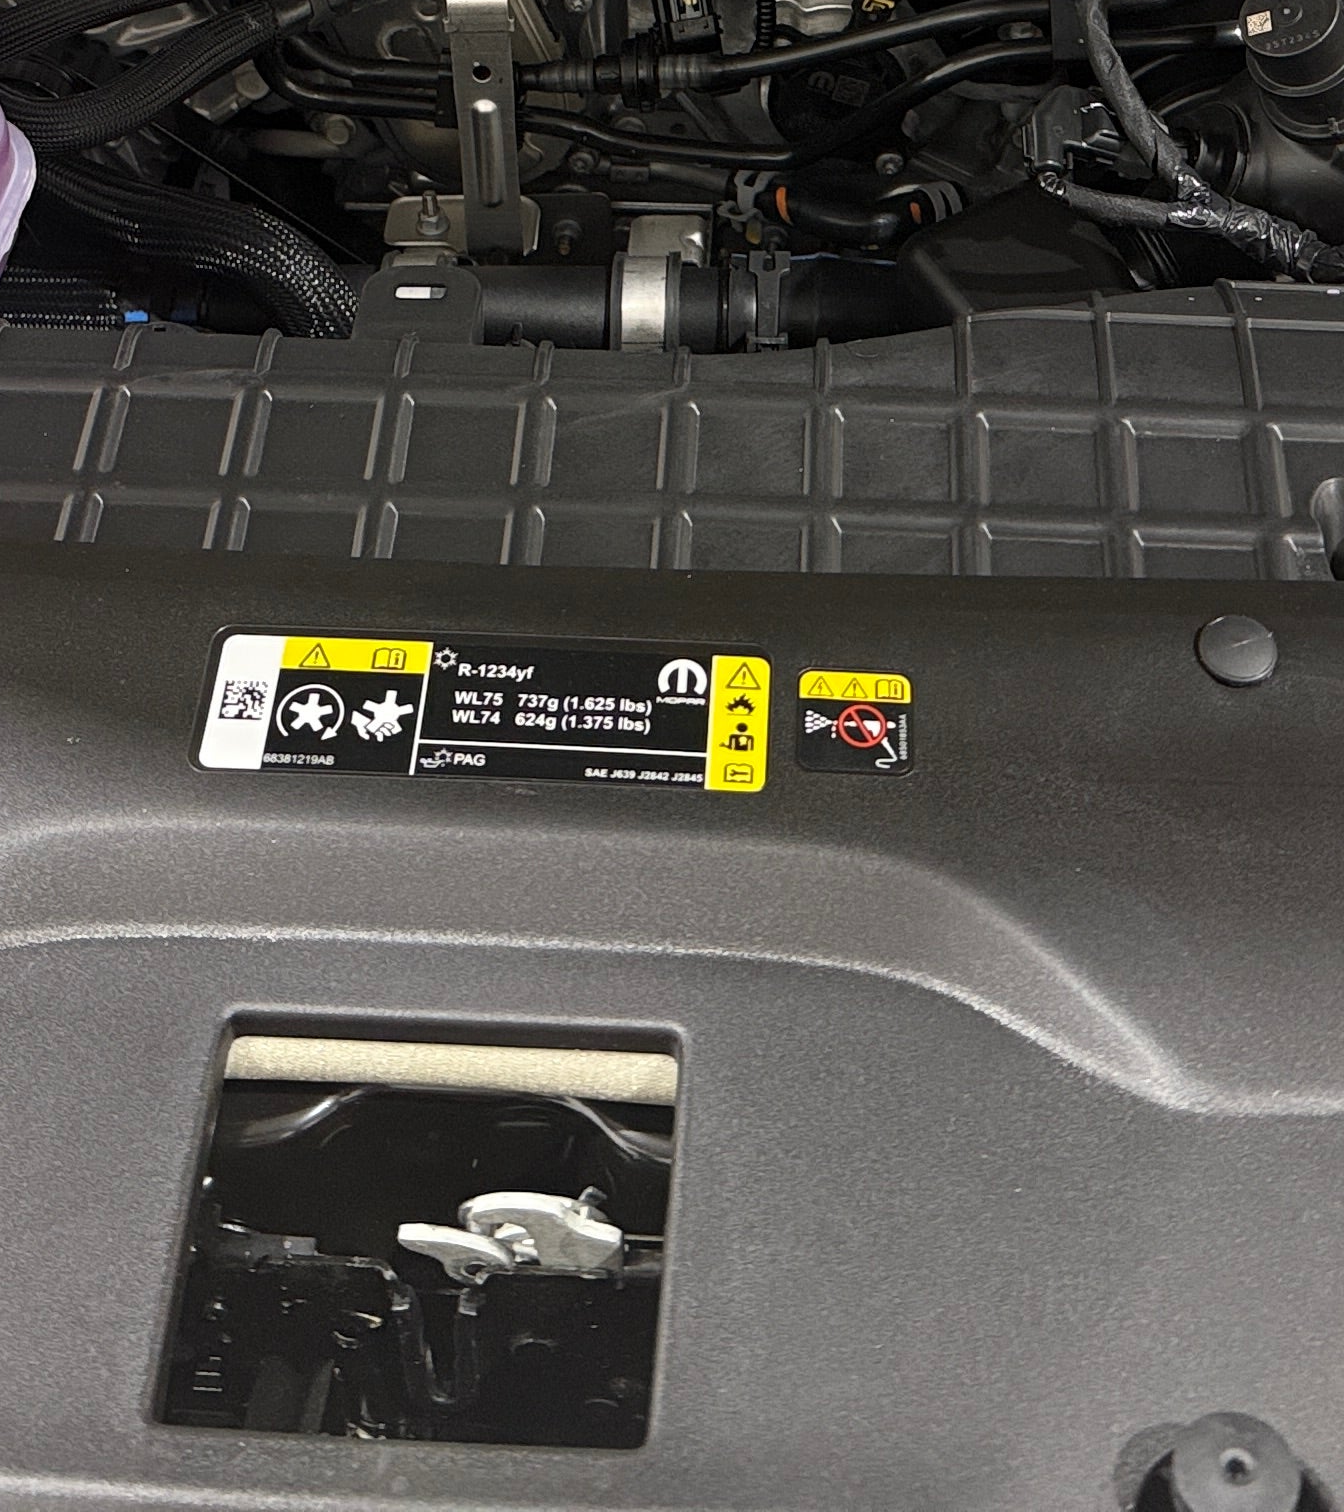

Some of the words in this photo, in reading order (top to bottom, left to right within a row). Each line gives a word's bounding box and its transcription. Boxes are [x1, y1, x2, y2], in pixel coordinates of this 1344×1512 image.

[457, 662, 535, 683] R-1234yf
[454, 690, 504, 707] WL75
[517, 693, 560, 712] 737g
[562, 695, 616, 713] (1.625
[619, 698, 654, 717] lbs)
[656, 695, 706, 706] MOPAR
[451, 708, 501, 725] WL74
[514, 712, 557, 731] 624g
[560, 714, 615, 732] (1.375
[617, 716, 652, 736] lbs)
[262, 752, 336, 766] 68381219AB
[453, 752, 487, 767] PAG
[584, 767, 608, 779] SAE
[609, 769, 636, 781] J639
